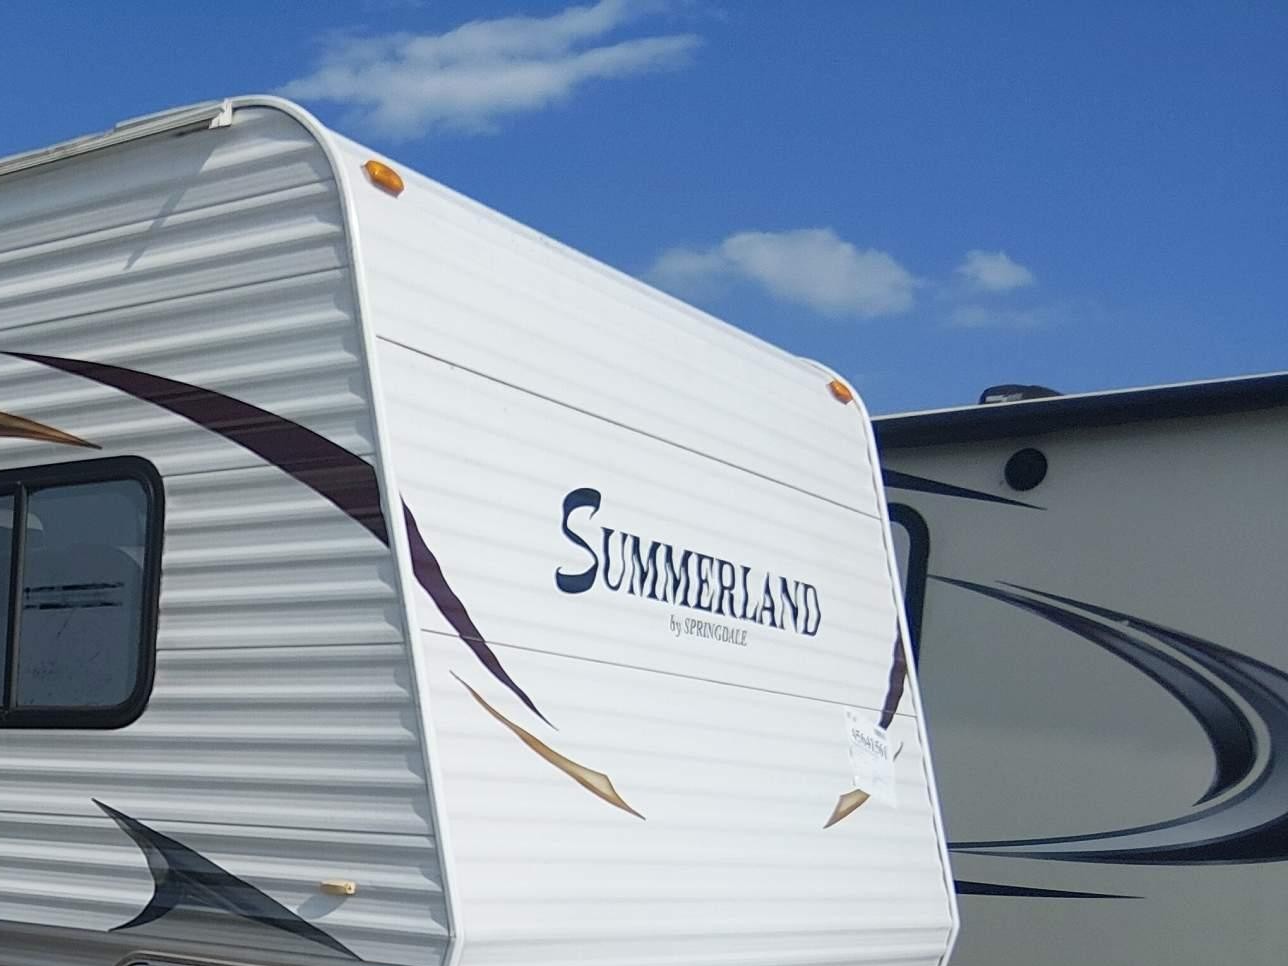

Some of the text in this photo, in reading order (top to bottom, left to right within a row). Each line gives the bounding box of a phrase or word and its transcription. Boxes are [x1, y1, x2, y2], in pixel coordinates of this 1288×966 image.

[555, 487, 822, 637] SUMMERLAND
[669, 614, 748, 646] by SPRINGDALE
